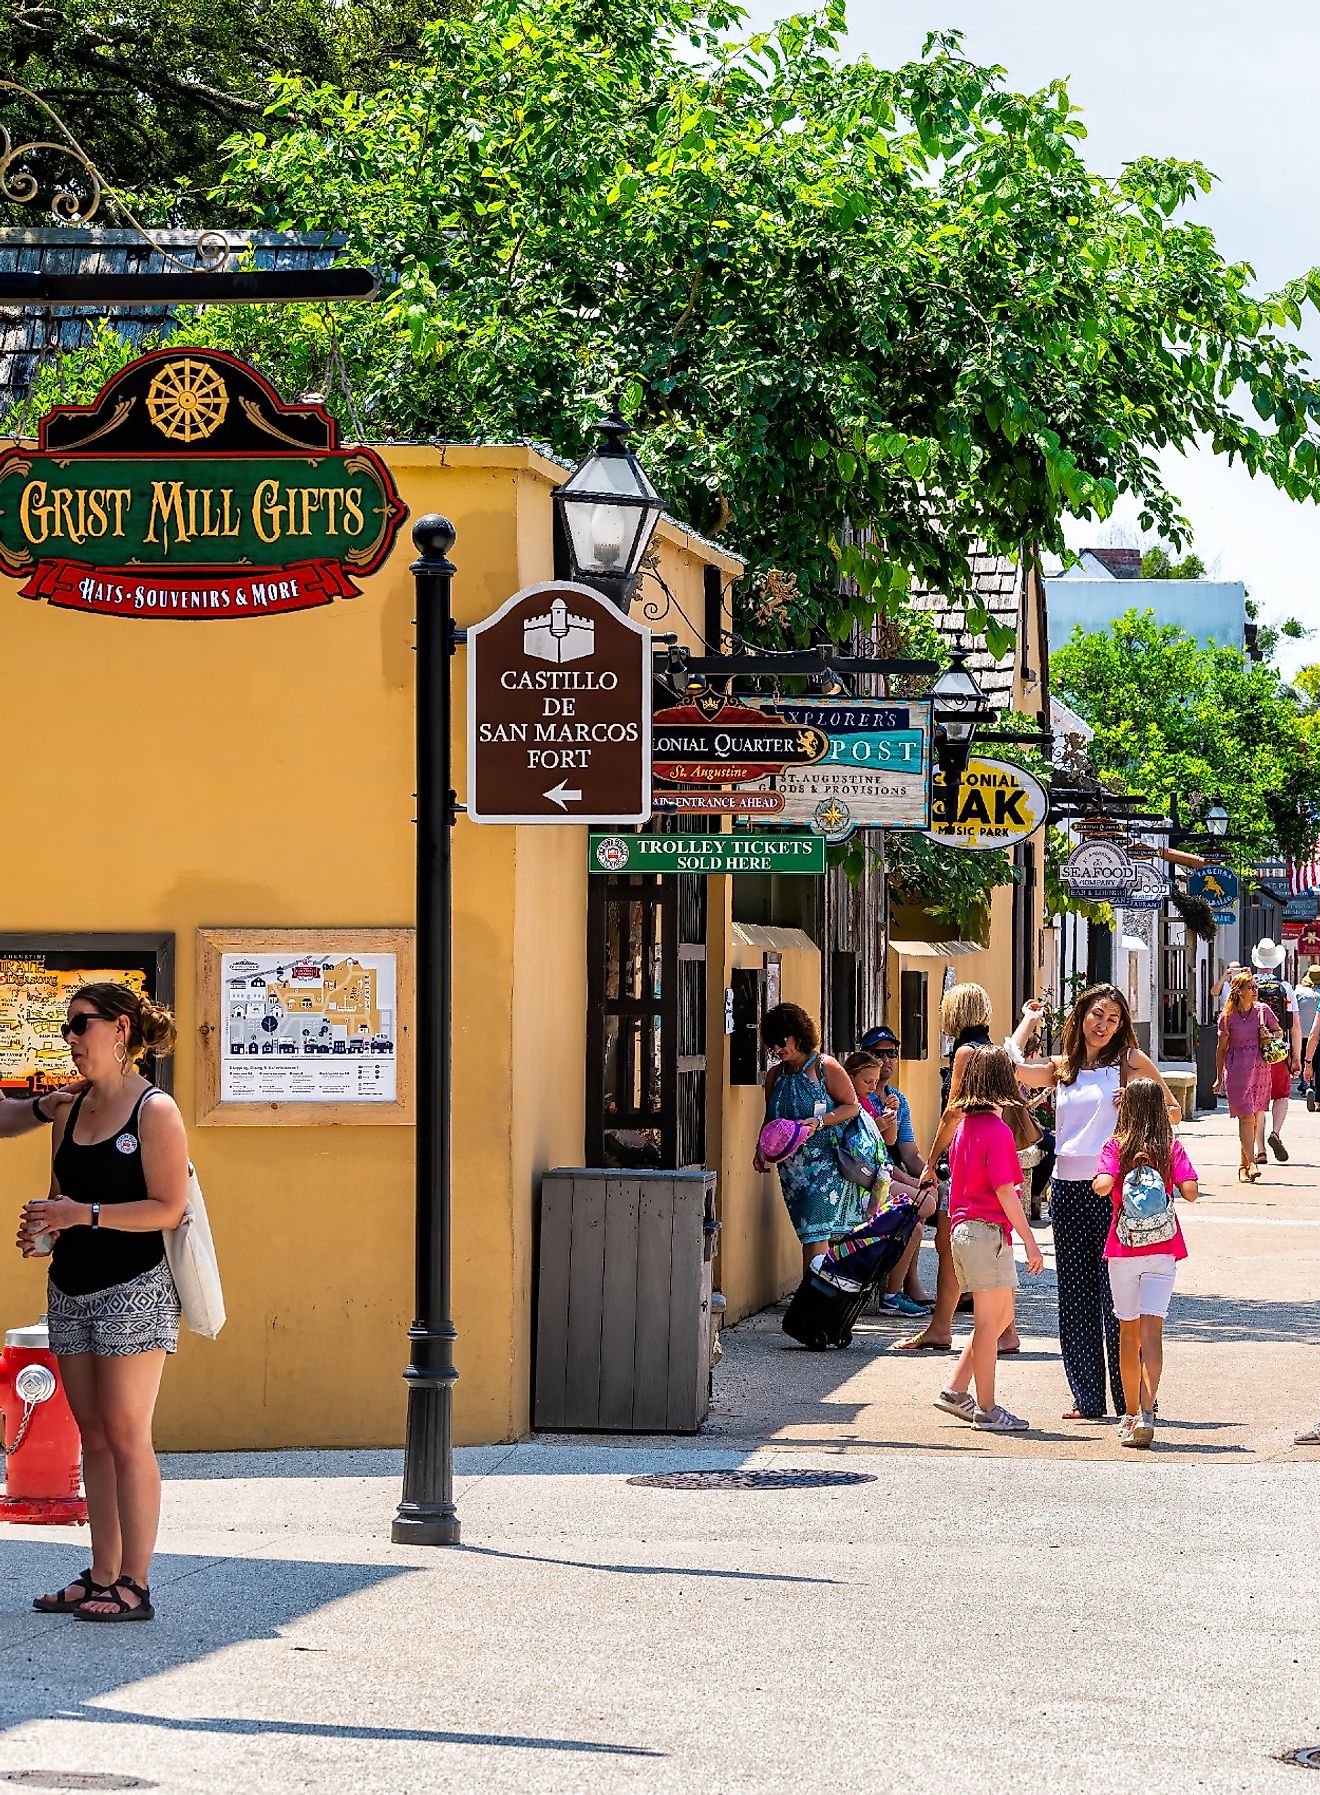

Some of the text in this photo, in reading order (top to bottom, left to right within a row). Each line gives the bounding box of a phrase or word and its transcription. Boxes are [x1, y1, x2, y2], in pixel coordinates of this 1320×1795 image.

[19, 479, 365, 556] GRIST MILL GIFTS
[78, 577, 300, 609] HATS SOUVENIRS & MORE
[500, 671, 618, 690] CASTILLO
[542, 697, 575, 717] DE
[788, 711, 897, 727] XPLORER'S
[479, 722, 638, 743] SAN MARCOS
[652, 733, 795, 758] LONIAL QUARTER
[829, 739, 917, 761] POST
[526, 749, 592, 769] FORT
[669, 764, 748, 780] St. Augustine
[803, 775, 882, 784] AUGUSTINE
[759, 783, 907, 795] GODS & PROVISIONS
[677, 797, 736, 808] ENTRANCE
[739, 797, 779, 808] AHEAD
[957, 788, 1027, 825] AK
[980, 827, 1009, 837] PARK
[637, 840, 724, 855] TROLLEY
[731, 840, 813, 855] TICKETS
[677, 857, 772, 870] SOLD HERE
[1062, 866, 1133, 879] SEAFOOD
